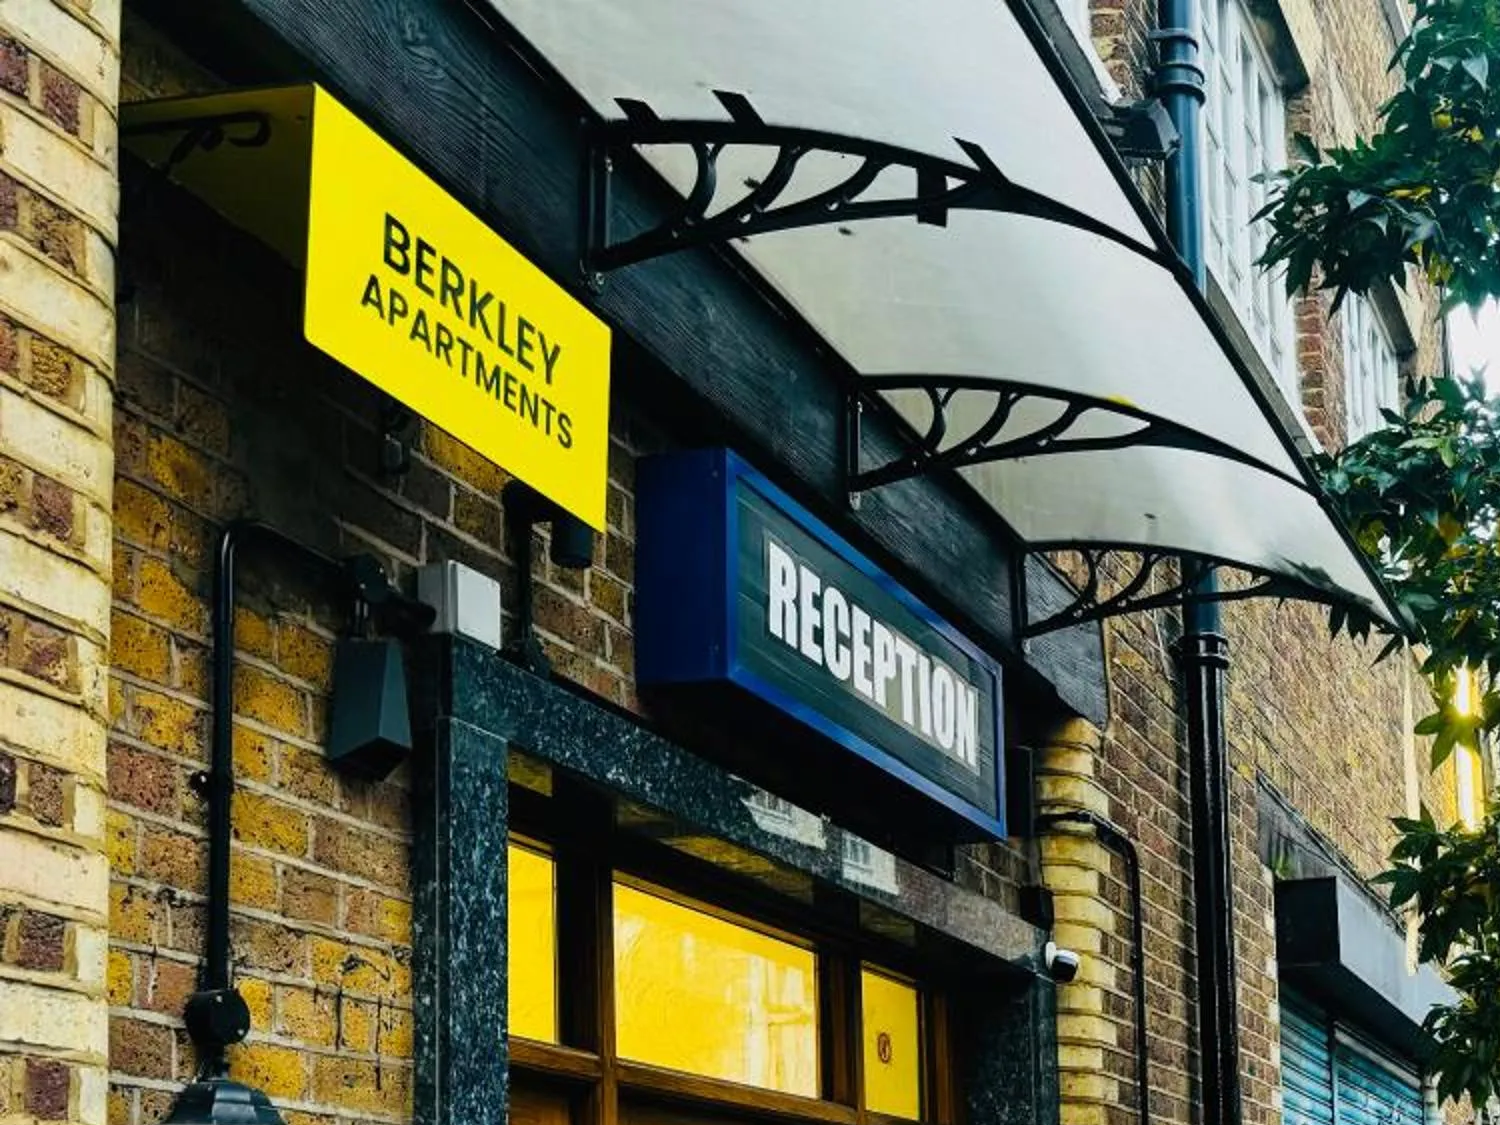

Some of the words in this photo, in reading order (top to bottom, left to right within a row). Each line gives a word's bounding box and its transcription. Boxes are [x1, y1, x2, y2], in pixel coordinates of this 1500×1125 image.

[361, 274, 573, 449] APARTMENTS
[382, 212, 561, 386] BERKLEY
[767, 540, 978, 768] RECEPTION
